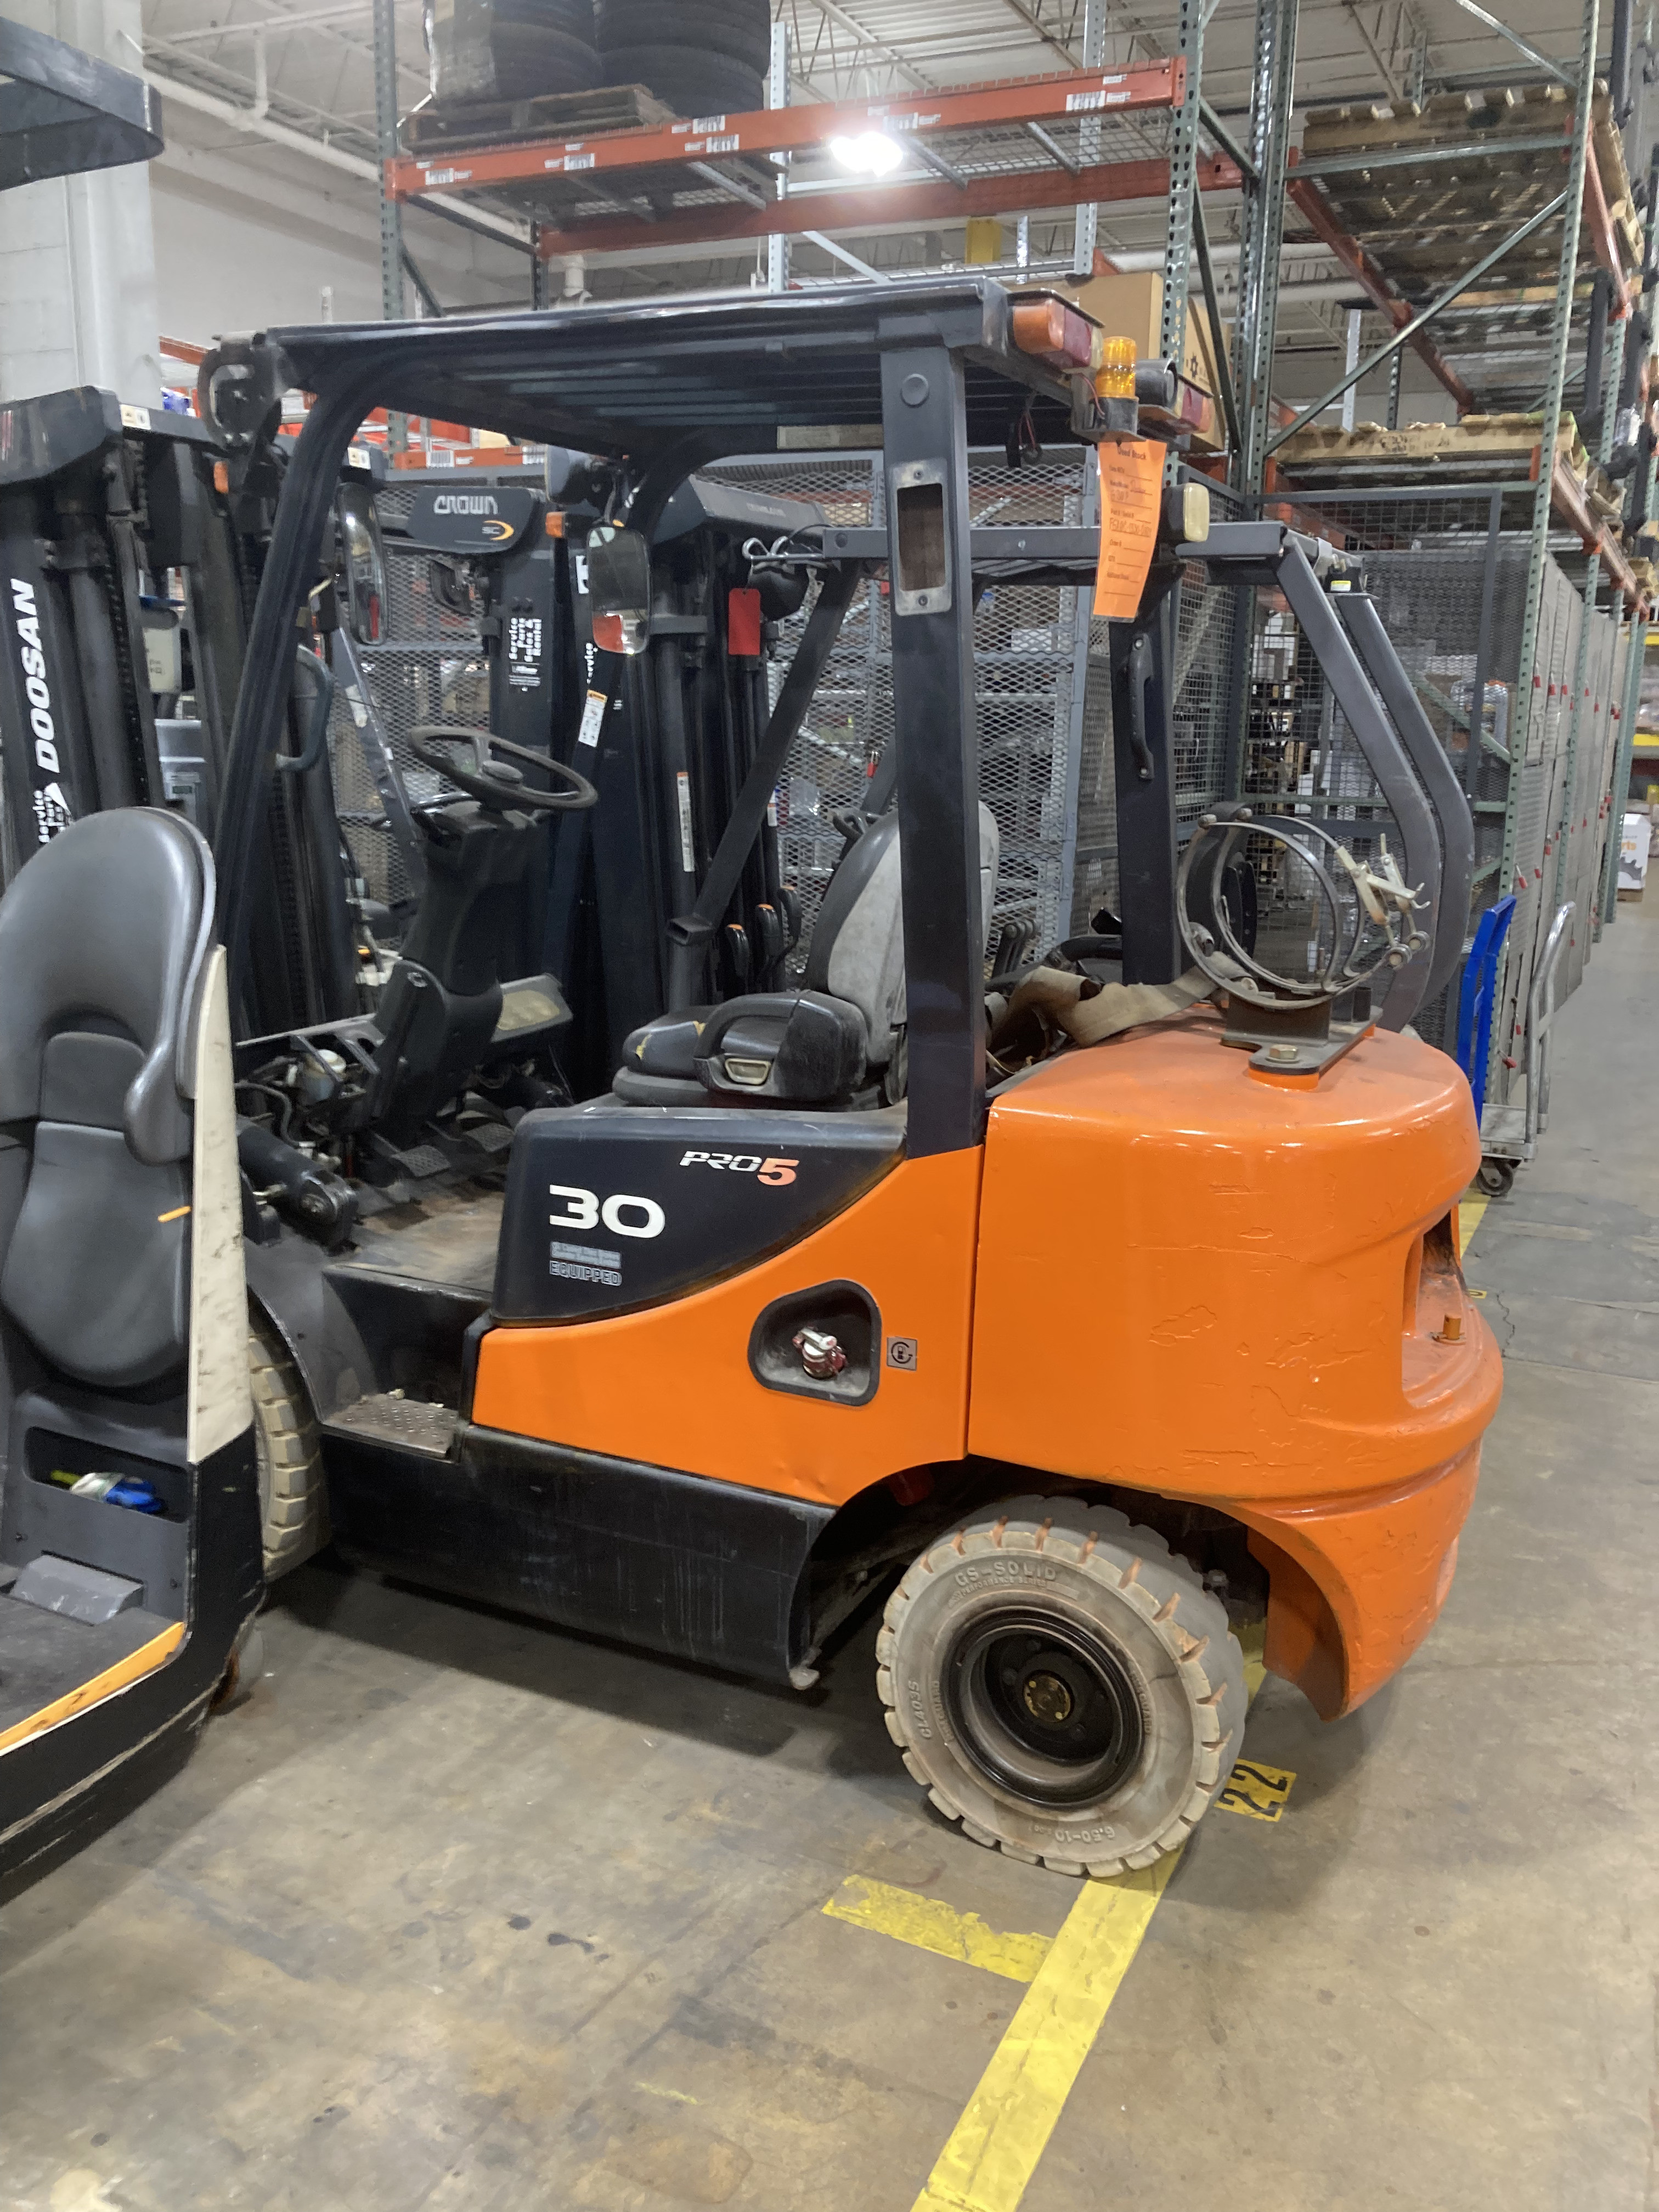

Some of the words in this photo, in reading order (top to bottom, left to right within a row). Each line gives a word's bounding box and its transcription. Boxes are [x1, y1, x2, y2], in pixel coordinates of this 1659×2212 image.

[433, 495, 498, 515] CROWN
[10, 578, 60, 774] DOOSAN
[680, 1151, 799, 1186] PRO5
[550, 1184, 665, 1238] 30
[549, 1260, 622, 1286] EQUIPPED
[1219, 1764, 1288, 1818] 22
